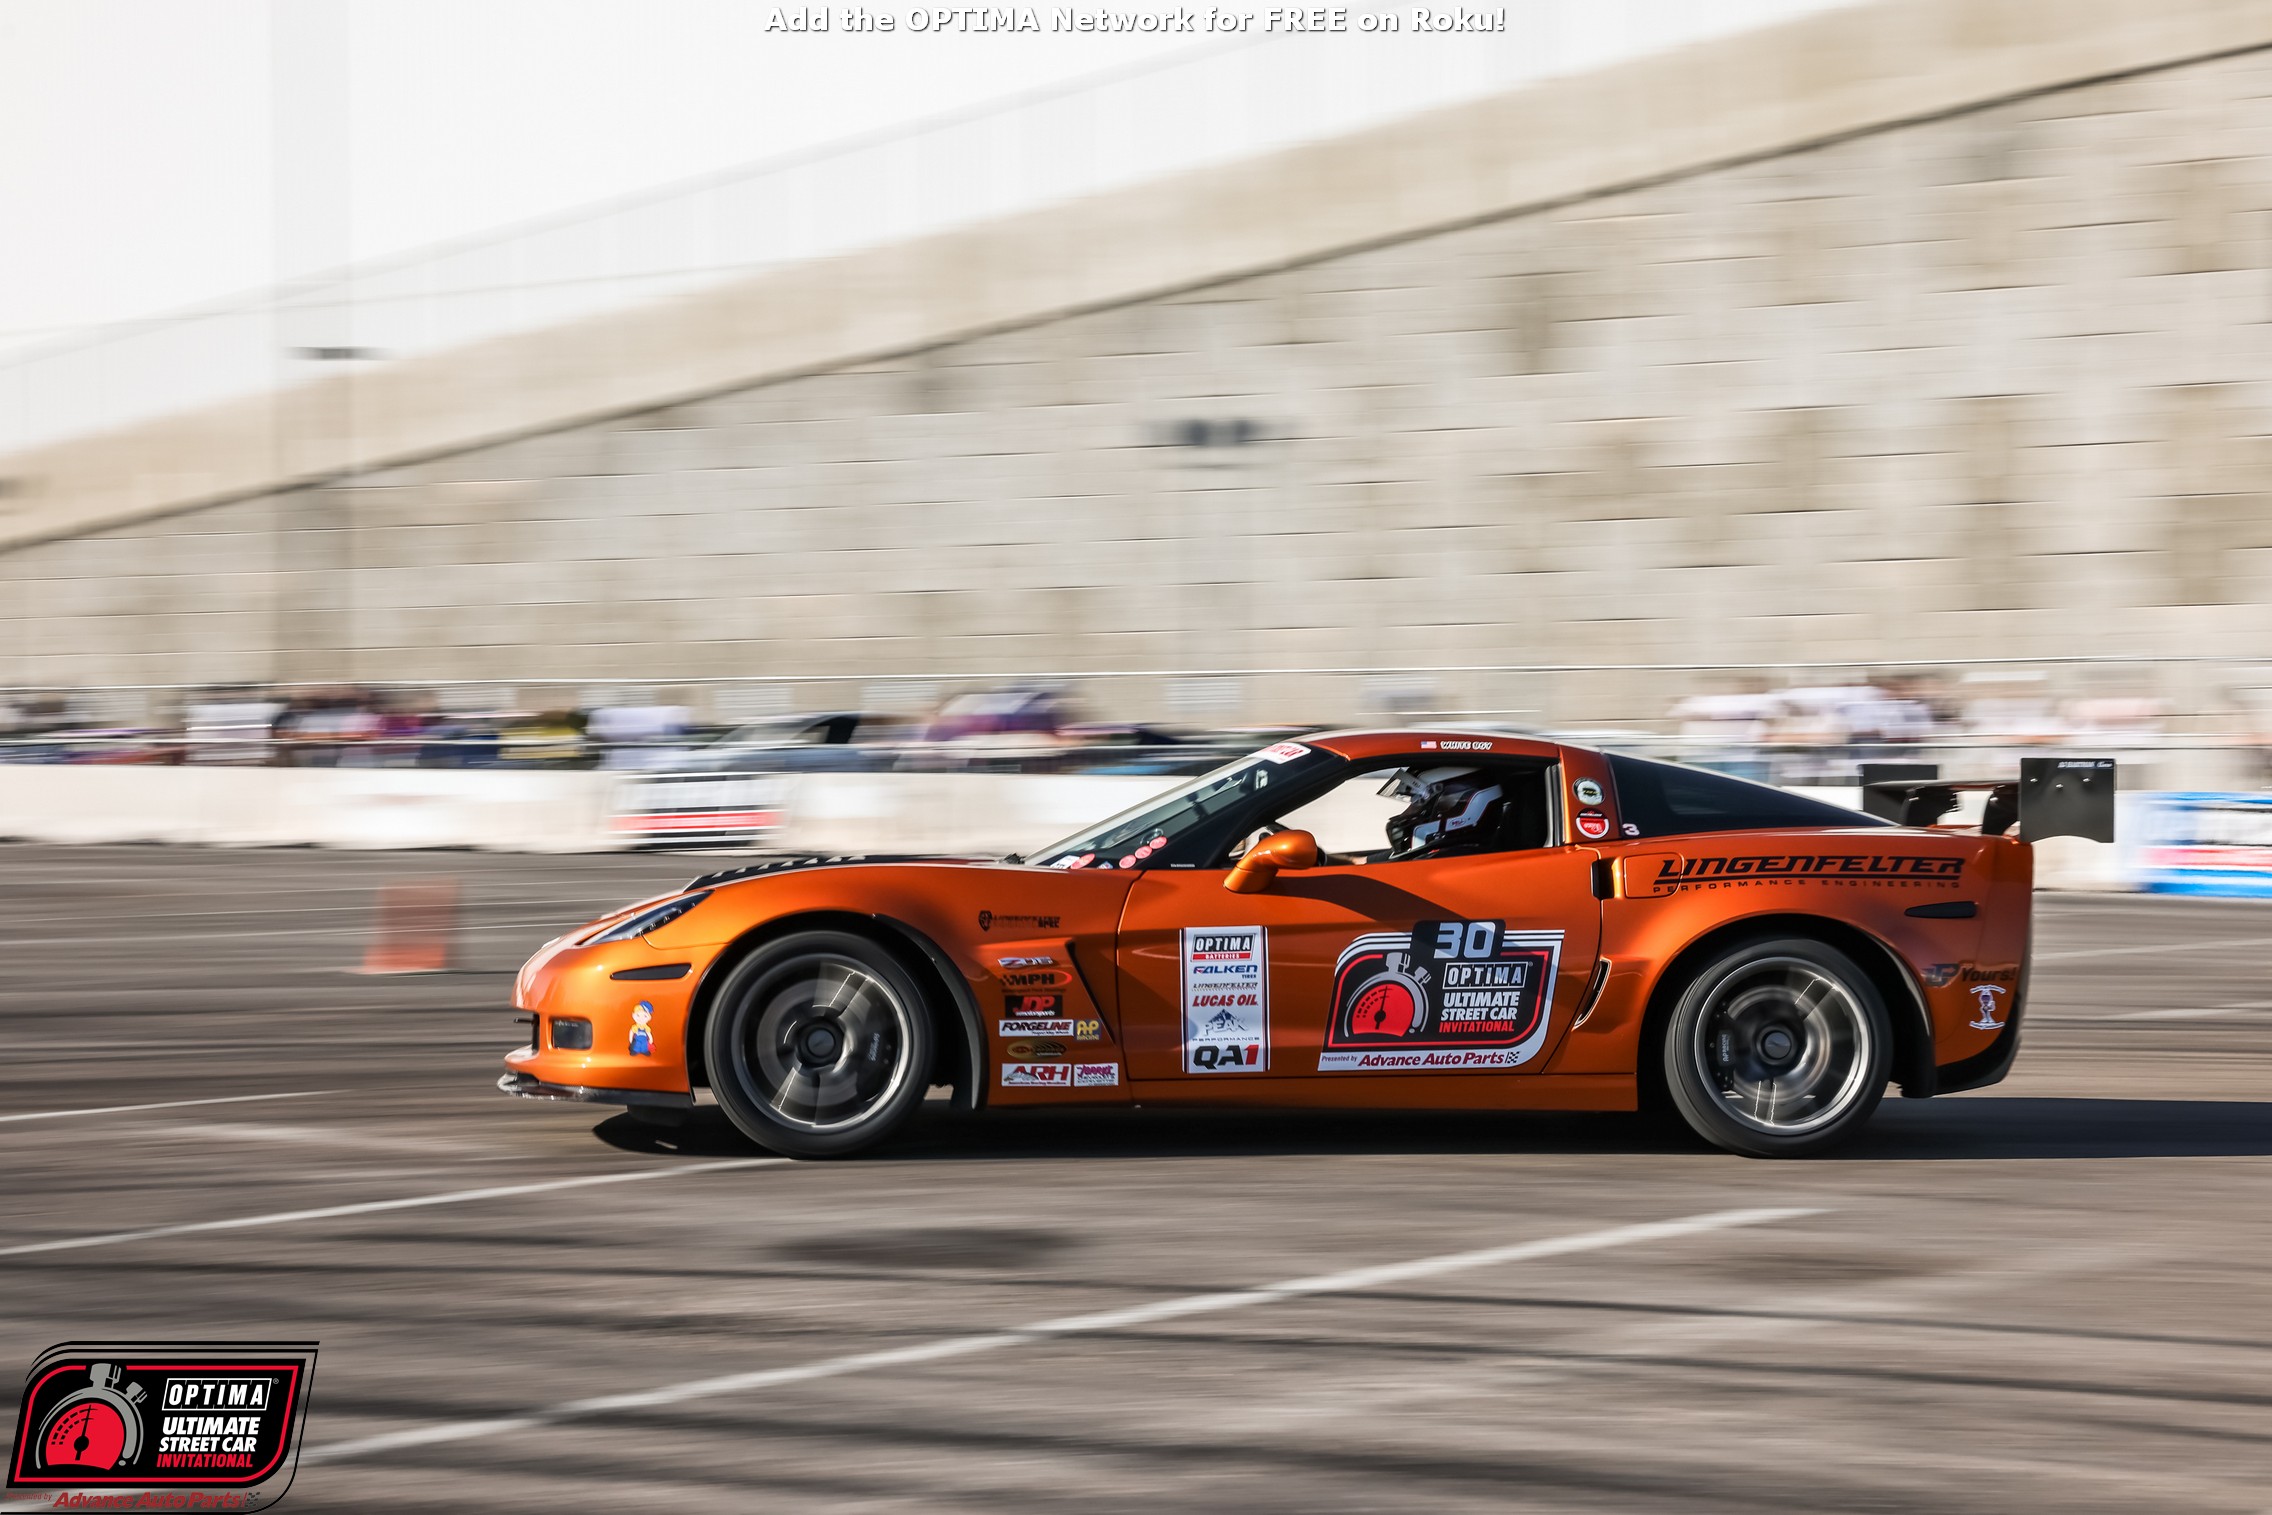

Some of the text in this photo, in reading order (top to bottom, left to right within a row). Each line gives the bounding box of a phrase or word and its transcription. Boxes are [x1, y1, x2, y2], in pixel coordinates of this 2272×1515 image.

[1622, 823, 1640, 836] 3
[1658, 856, 1965, 878] LINGENFELTER
[1653, 879, 1960, 893] PERFORMANCE ENGINEERING
[1195, 936, 1251, 952] OPTIMA
[1433, 922, 1496, 959] 30
[1193, 965, 1258, 974] FALKEN
[1447, 966, 1522, 986] OPTIMA
[1192, 994, 1257, 1007] LUCAS OIL
[1443, 992, 1521, 1008] ULTIMATE
[1440, 1007, 1518, 1021] STREET CAR
[1002, 1021, 1072, 1031] FORGELINE
[1439, 1021, 1515, 1033] INVITATIONAL
[1193, 1044, 1259, 1070] QA1
[1358, 1054, 1420, 1066] Advance
[1422, 1053, 1462, 1066] Auto
[1462, 1052, 1505, 1065] Parts
